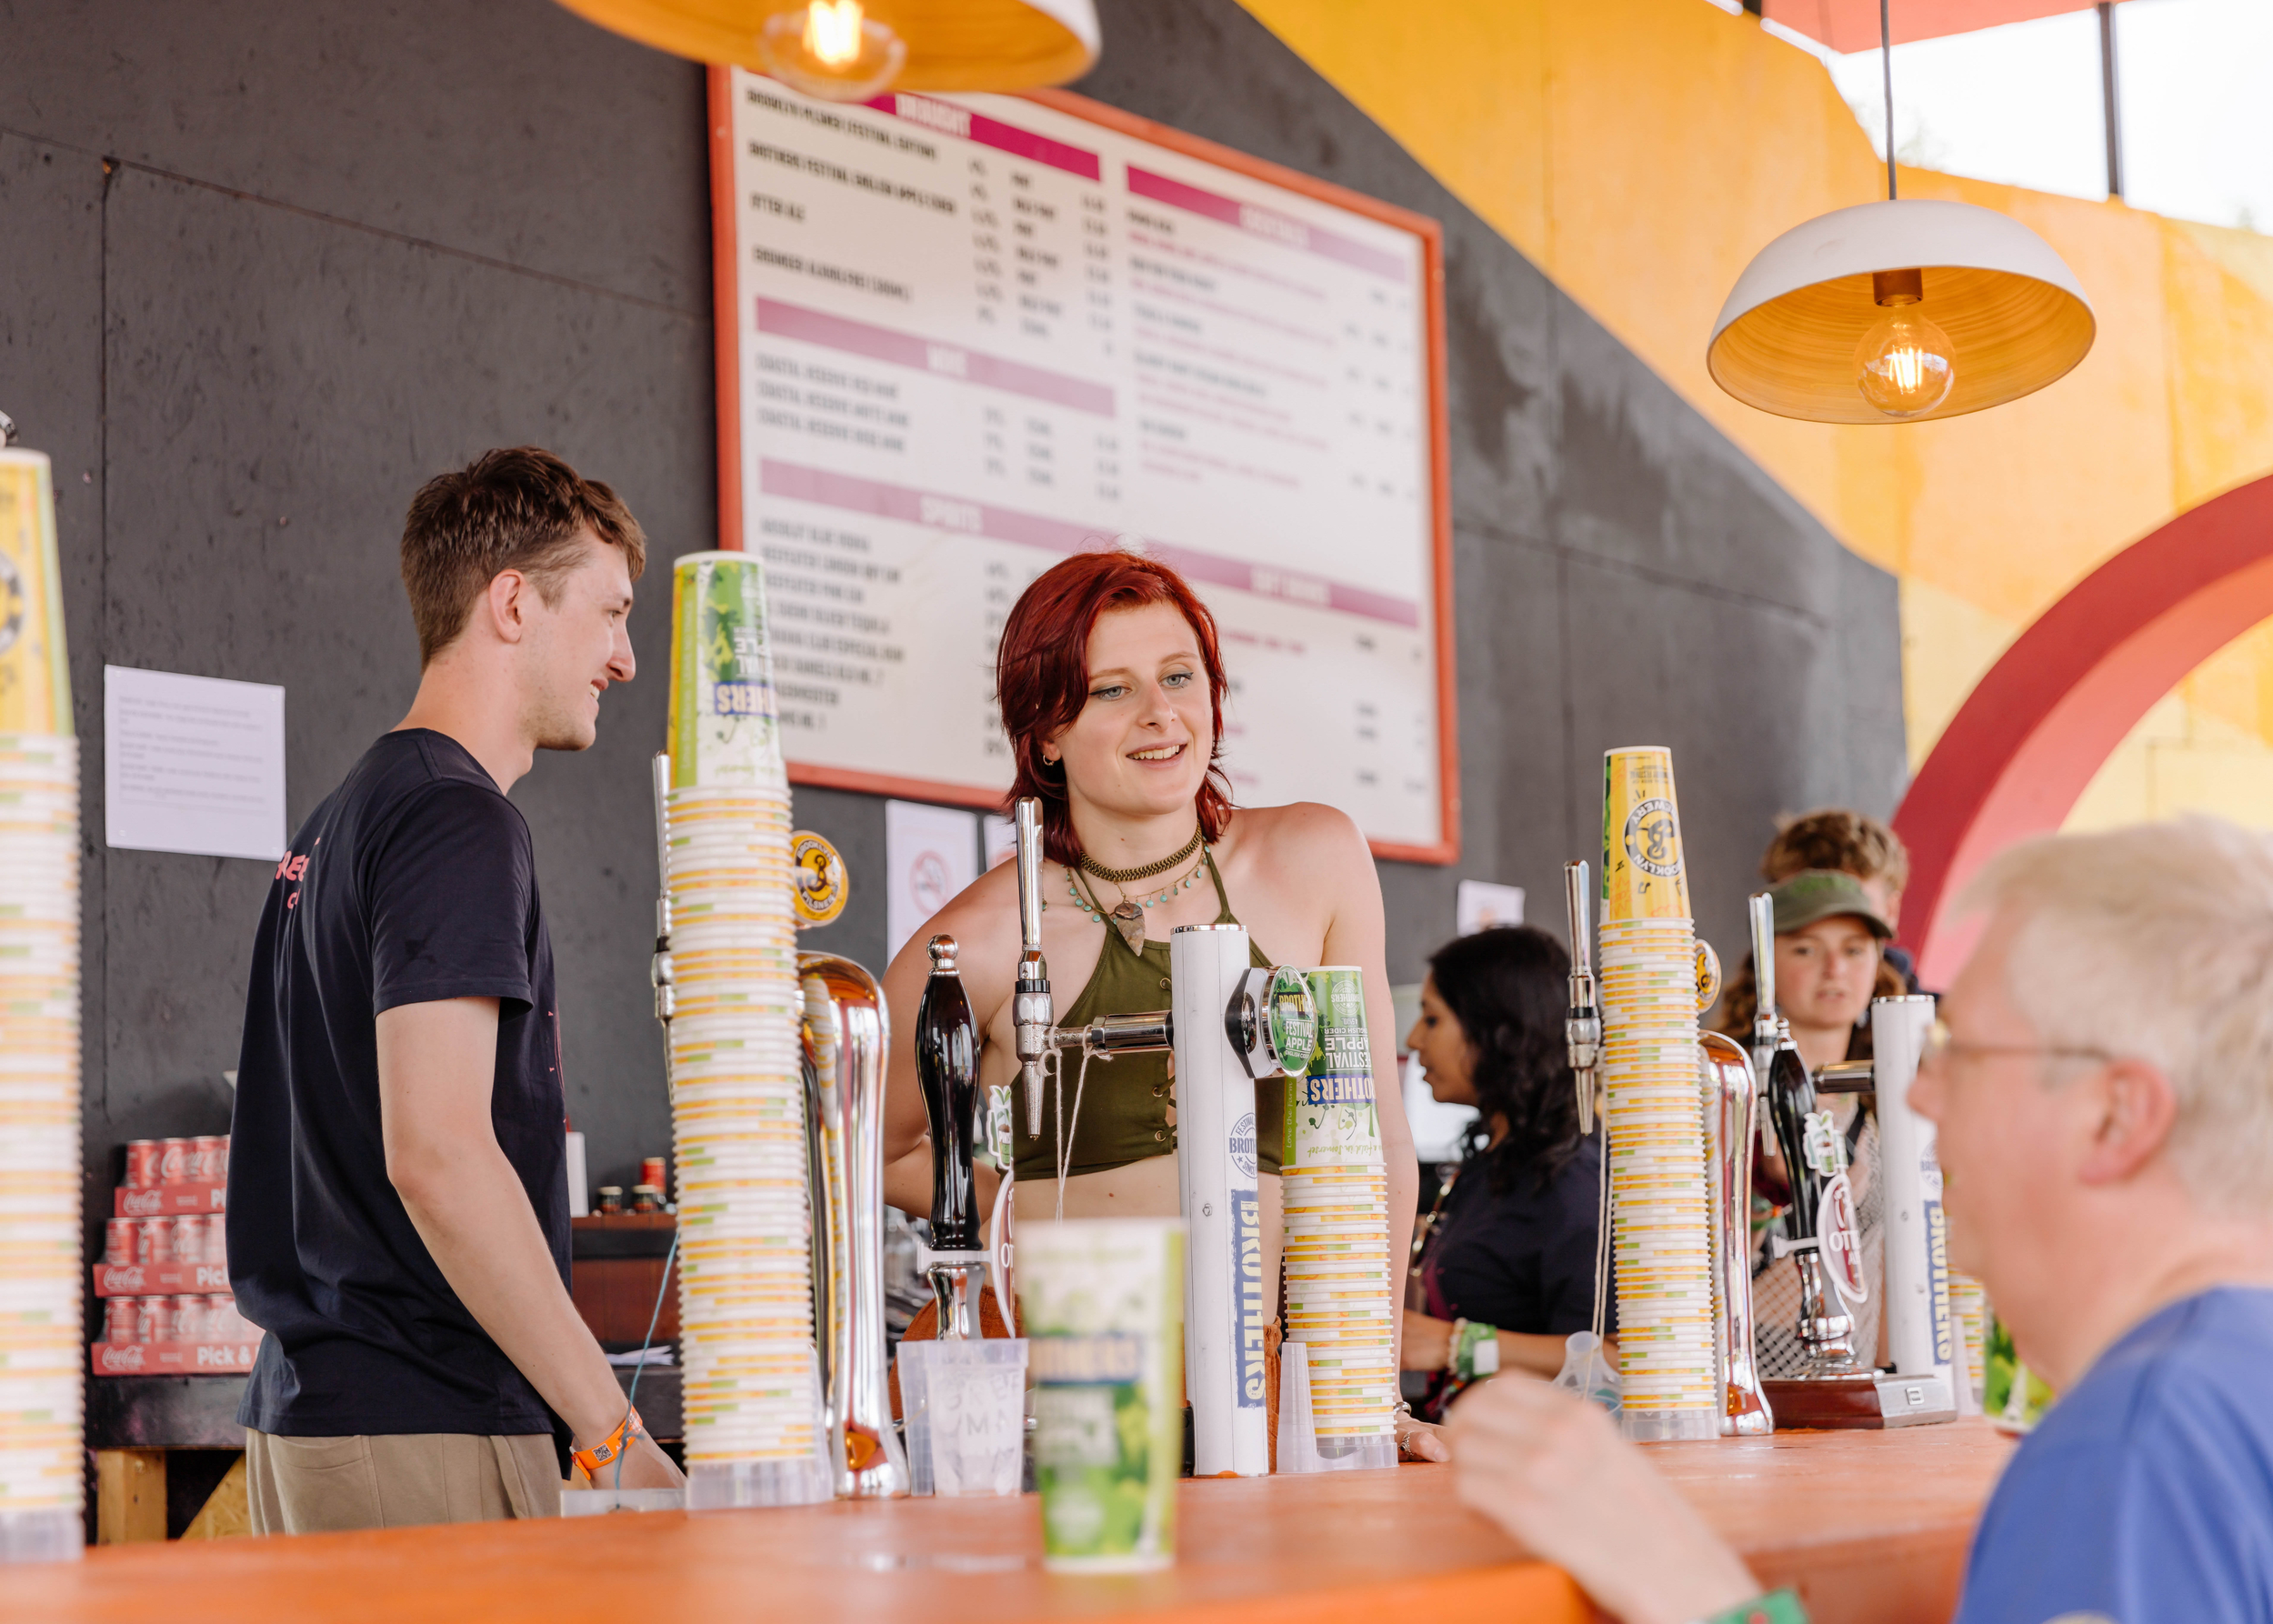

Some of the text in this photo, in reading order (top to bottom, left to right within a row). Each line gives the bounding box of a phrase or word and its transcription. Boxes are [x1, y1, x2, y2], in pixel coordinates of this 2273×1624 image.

[1286, 1020, 1313, 1038] FESTIVAL
[1286, 1037, 1313, 1051] APPLE
[1325, 1037, 1369, 1050] APPLE
[1327, 1052, 1371, 1068] FESTIVAL
[196, 1345, 235, 1367] Pick
[238, 1344, 252, 1365] &
